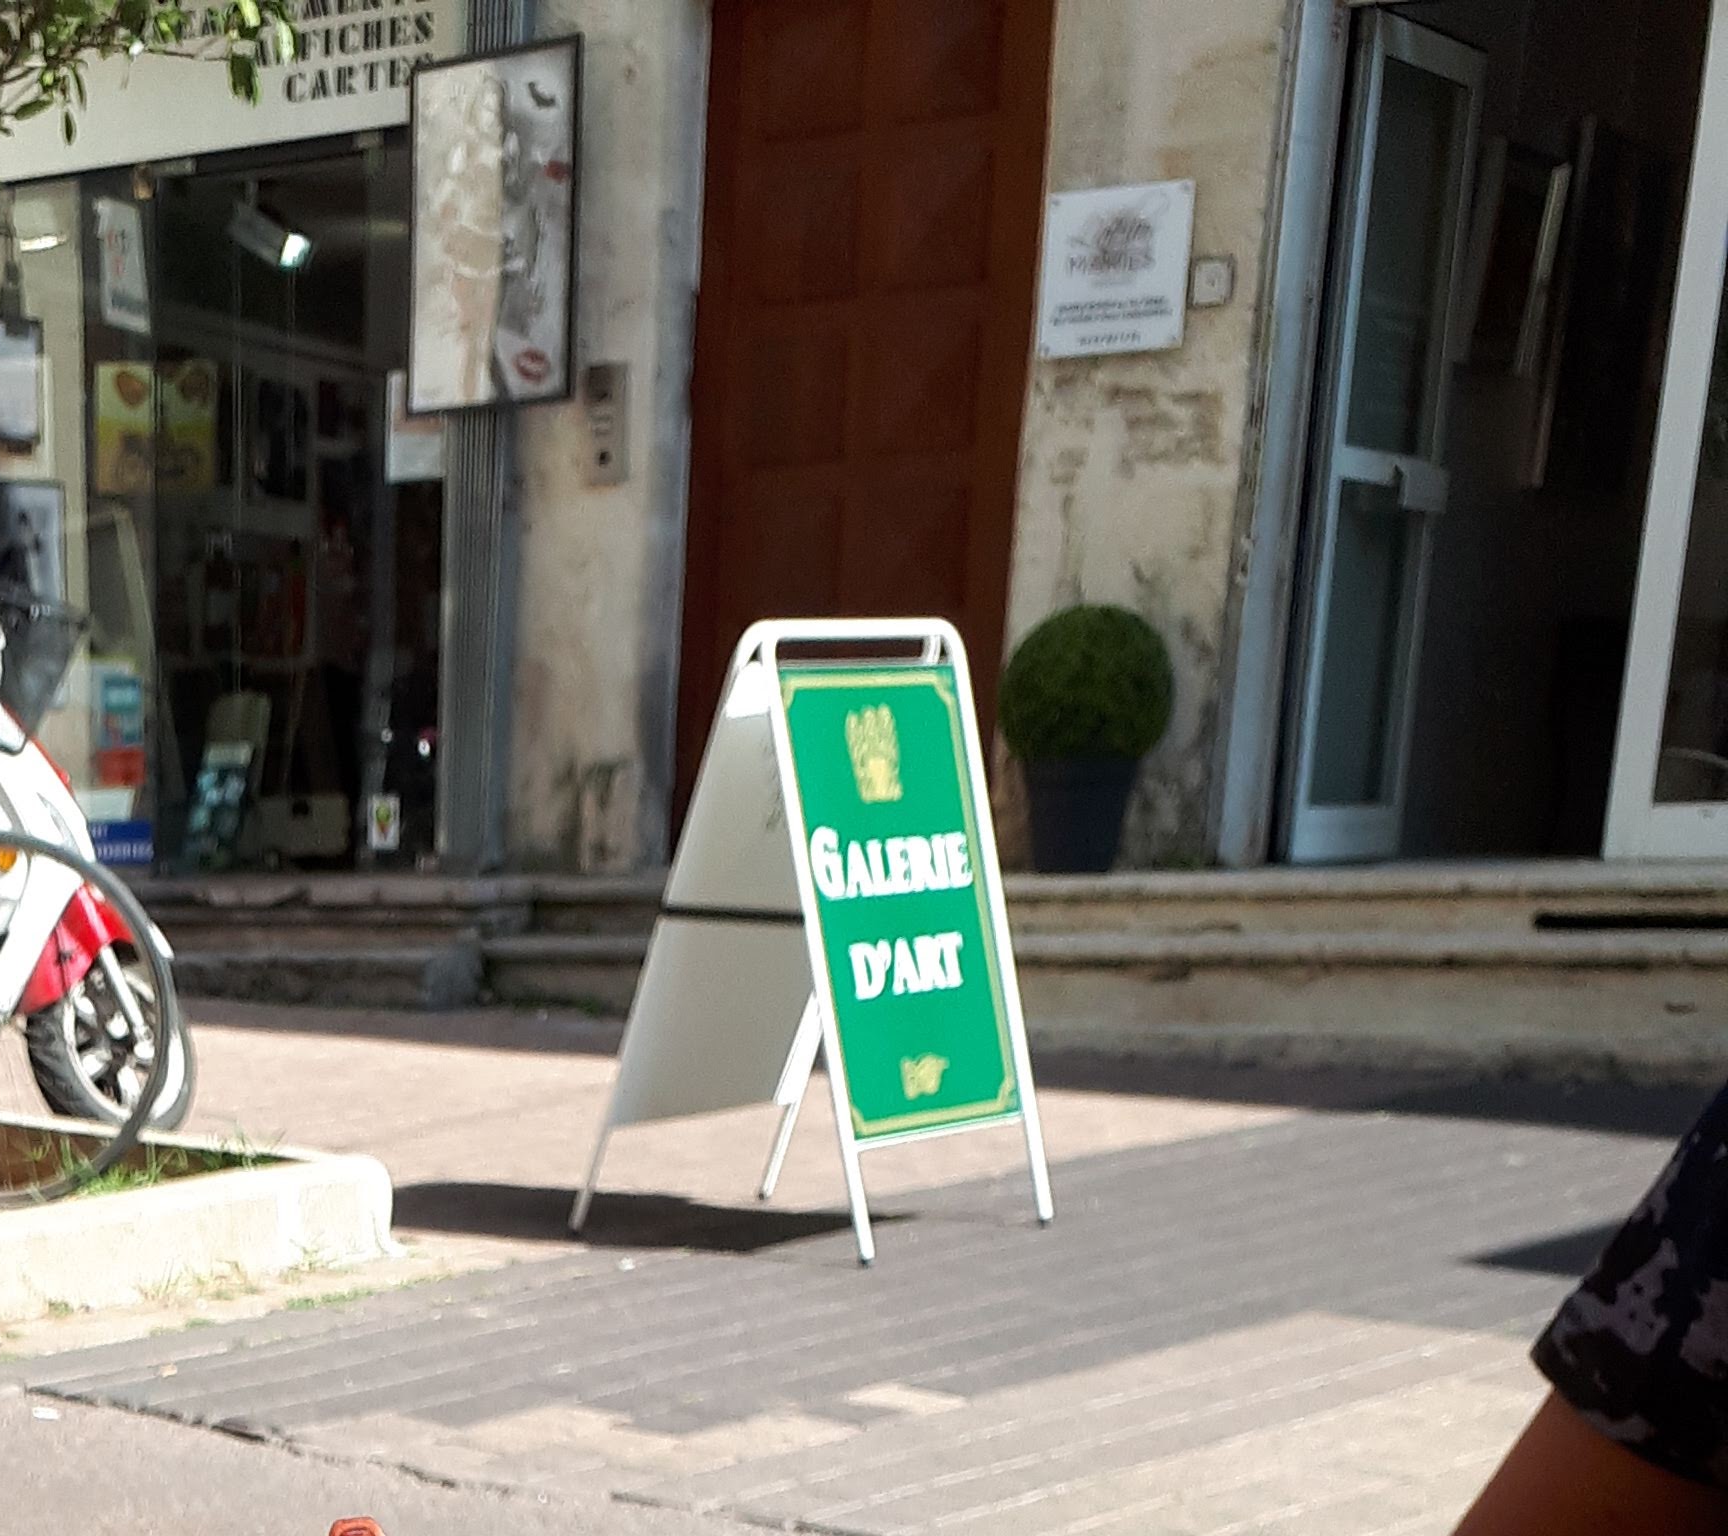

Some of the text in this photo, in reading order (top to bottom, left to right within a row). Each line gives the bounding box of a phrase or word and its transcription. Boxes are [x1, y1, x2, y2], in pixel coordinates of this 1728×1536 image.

[256, 11, 434, 66] AFICHES
[283, 54, 432, 102] CARTE
[809, 826, 974, 901] GALERIE
[849, 932, 964, 1001] D'ART
